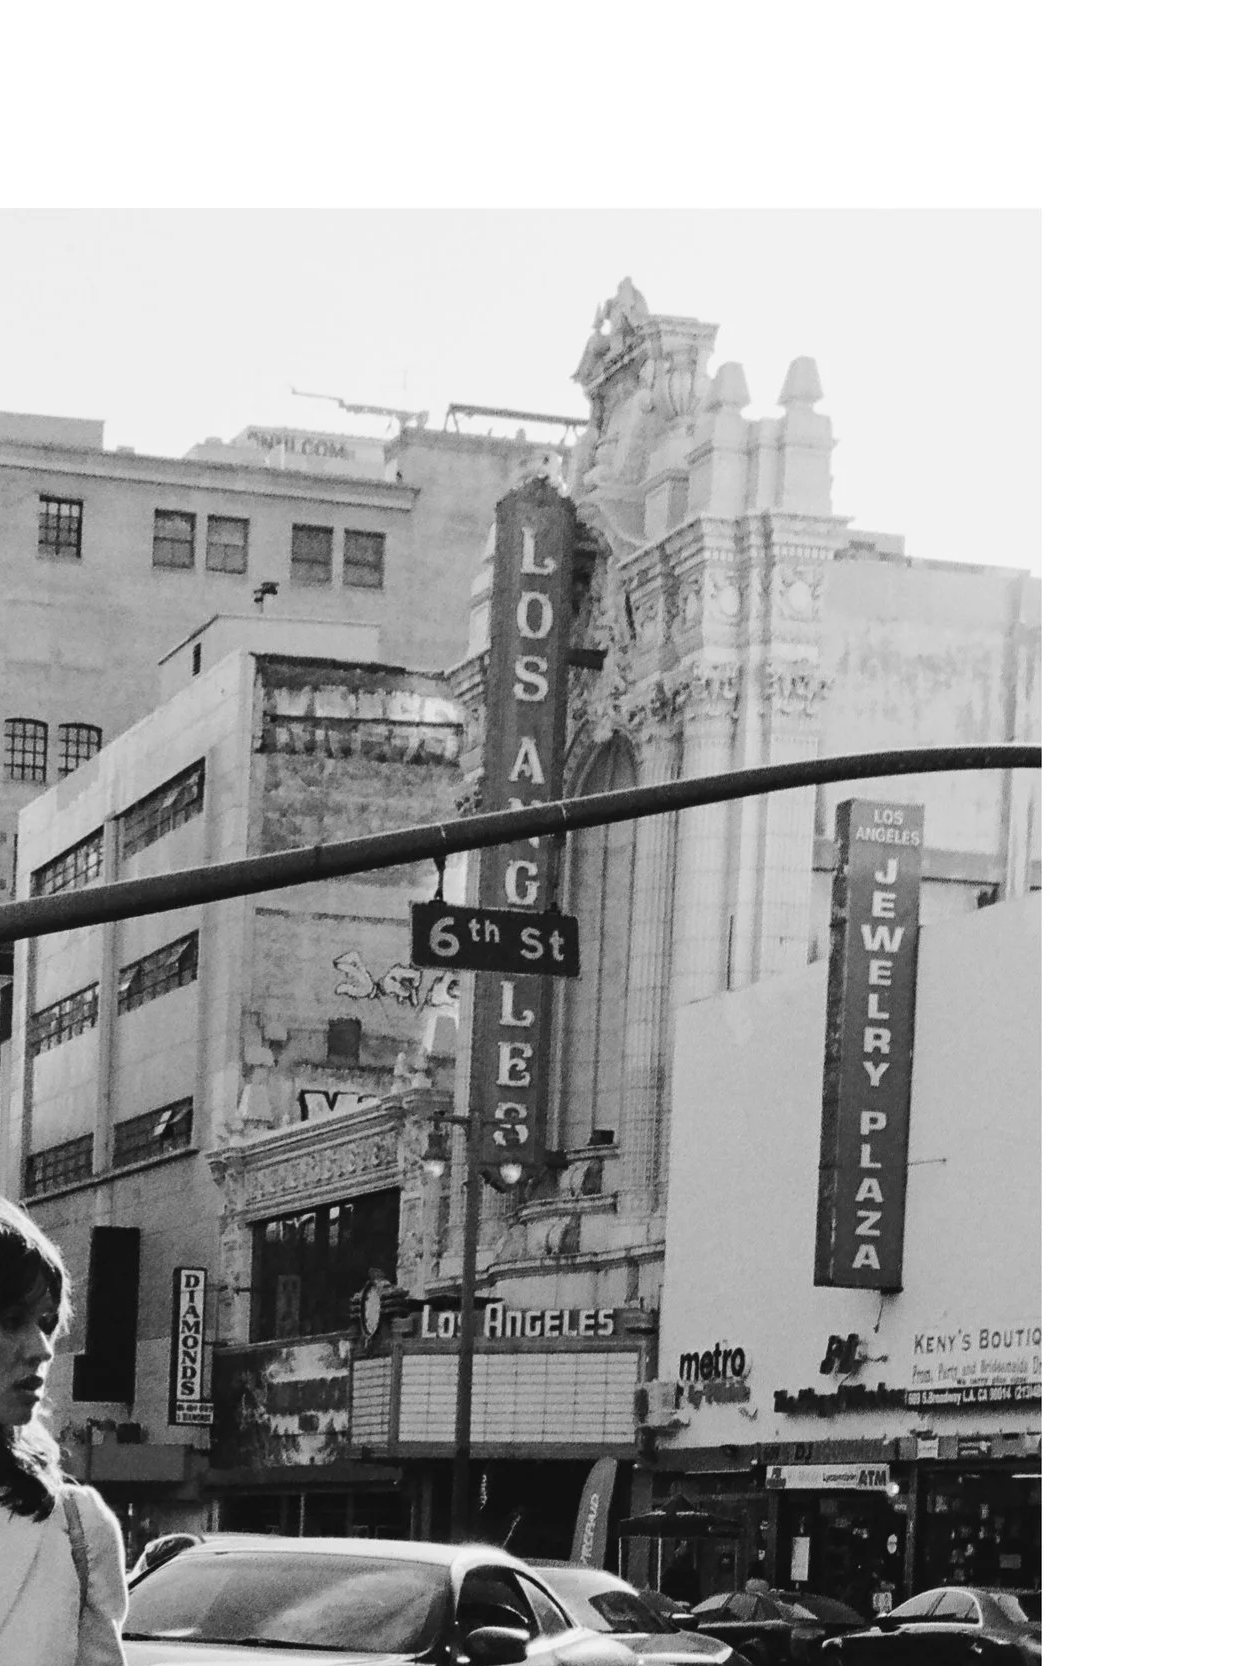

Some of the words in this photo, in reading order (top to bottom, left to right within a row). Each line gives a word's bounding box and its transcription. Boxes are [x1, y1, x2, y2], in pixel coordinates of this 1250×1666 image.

[513, 525, 556, 702] LOS
[855, 825, 920, 848] ANGELES
[873, 809, 904, 826] LOS
[428, 916, 500, 958] 6th
[519, 927, 566, 961] St
[859, 857, 906, 1088] JEWELRY
[851, 1110, 888, 1271] PLAZA
[180, 1274, 201, 1396] DIAMONDS
[913, 1328, 971, 1355] KENY'S
[679, 1342, 746, 1381] metro
[857, 1469, 887, 1488] ATM
